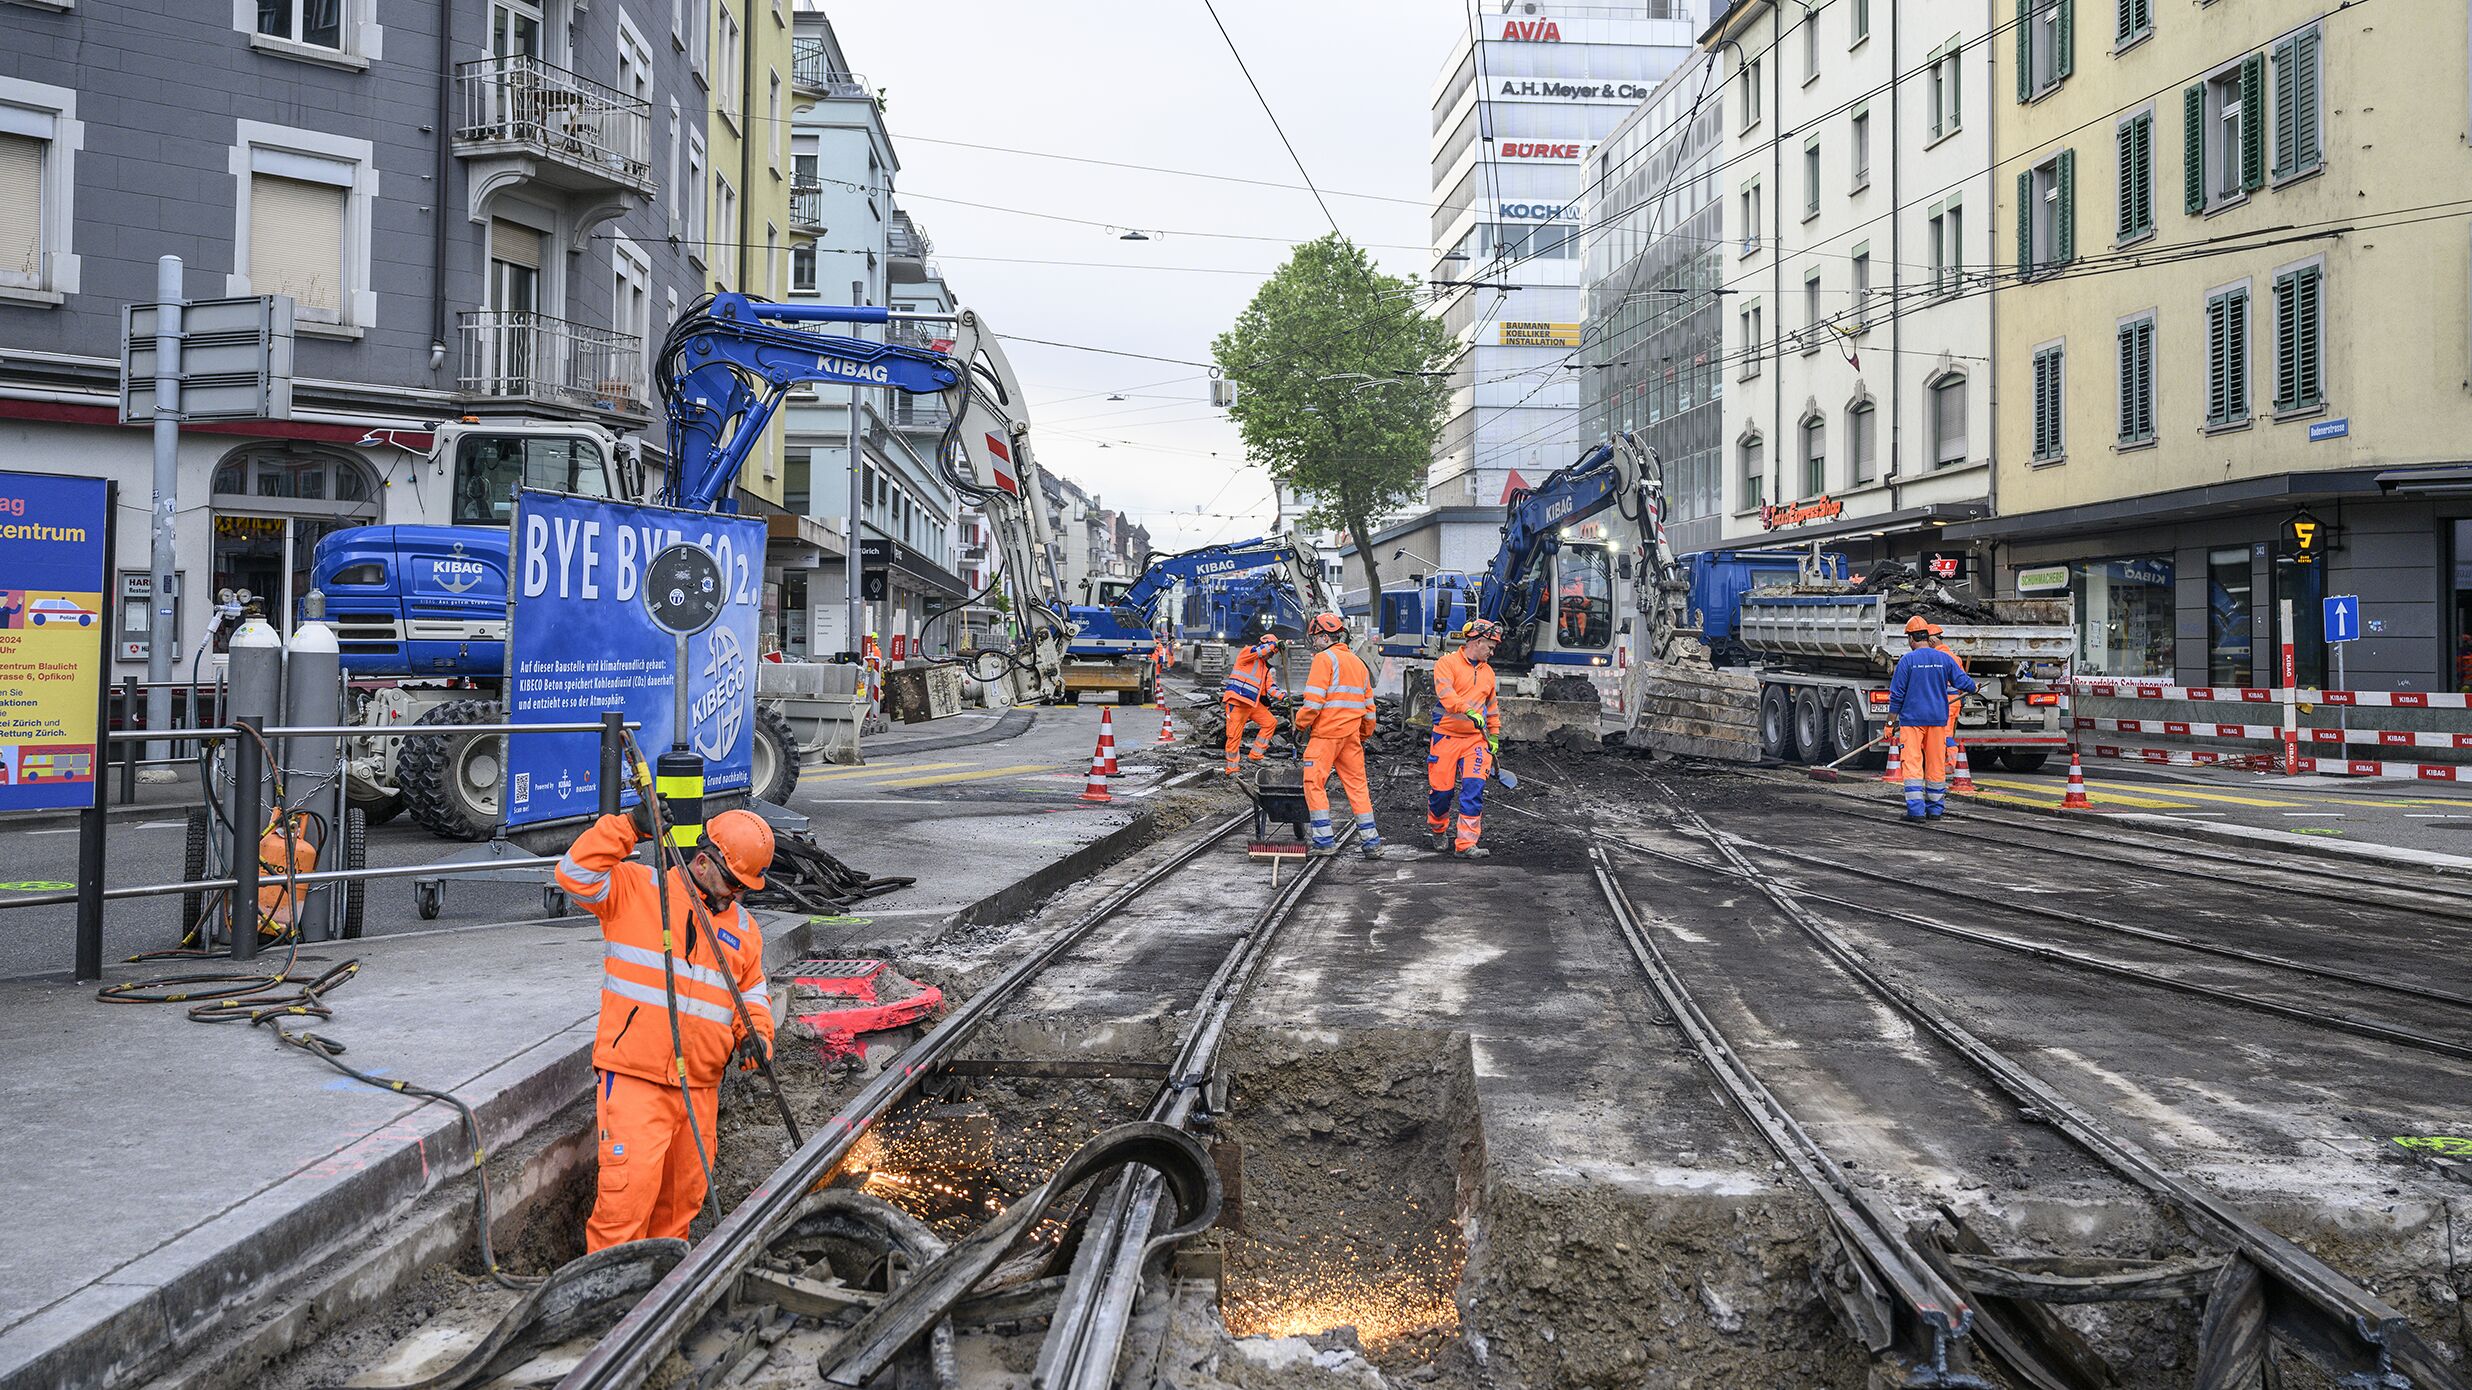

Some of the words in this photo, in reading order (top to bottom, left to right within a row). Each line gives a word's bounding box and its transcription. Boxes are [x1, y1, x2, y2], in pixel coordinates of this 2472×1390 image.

[1542, 82, 1599, 99] Meyer
[1602, 84, 1615, 98] &
[1618, 84, 1648, 99] Cie
[1501, 143, 1580, 159] BÜRKE
[1500, 203, 1560, 219] KOCH
[1506, 322, 1550, 330] BAUMANN
[1506, 338, 1565, 346] INSTALLATION
[816, 355, 888, 383] KIBAG
[2311, 424, 2345, 437] Badenerstrasse
[1545, 496, 1573, 523] KIBAG
[0, 523, 86, 542] entrum
[524, 514, 600, 600] BYE
[617, 525, 682, 601] BY
[860, 547, 880, 555] ürich
[2256, 546, 2265, 556] 343
[433, 561, 483, 574] KIBAG
[1196, 560, 1235, 575] KIBAG
[129, 578, 151, 586] HAR
[2021, 571, 2065, 586] SCHUHMACHEREI
[38, 662, 78, 670] Blaulicht
[520, 660, 532, 673] Auf
[533, 660, 554, 673] dieser
[555, 660, 585, 672] Baustelle
[586, 660, 599, 672] wird
[600, 659, 645, 671] klimafreundlich
[645, 658, 667, 672] gebaut:
[27, 673, 35, 681] 6,
[38, 672, 75, 681] Opfikon)
[519, 679, 543, 692] KIBECO
[544, 678, 563, 691] Beton
[564, 677, 594, 692] speichert
[594, 676, 632, 690] Kohlendioxid
[646, 673, 674, 688] dauerhaft
[9, 688, 23, 696] Sie
[692, 665, 745, 728] KIBECO
[518, 697, 532, 710] und
[532, 697, 561, 709] entzieht
[561, 698, 569, 708] es
[570, 697, 577, 707] so
[578, 695, 589, 707] der
[590, 693, 626, 708] Atmosphäre.
[13, 719, 42, 727] Zürich
[36, 729, 67, 737] Zürich.
[1473, 747, 1482, 775] KIBAG
[707, 774, 722, 786] Grund
[722, 770, 749, 784] nachhaltig.
[534, 783, 549, 791] Powered
[549, 782, 554, 791] by
[576, 783, 597, 793] neustark
[513, 806, 522, 814] Scan
[721, 932, 737, 947] KIBAG
